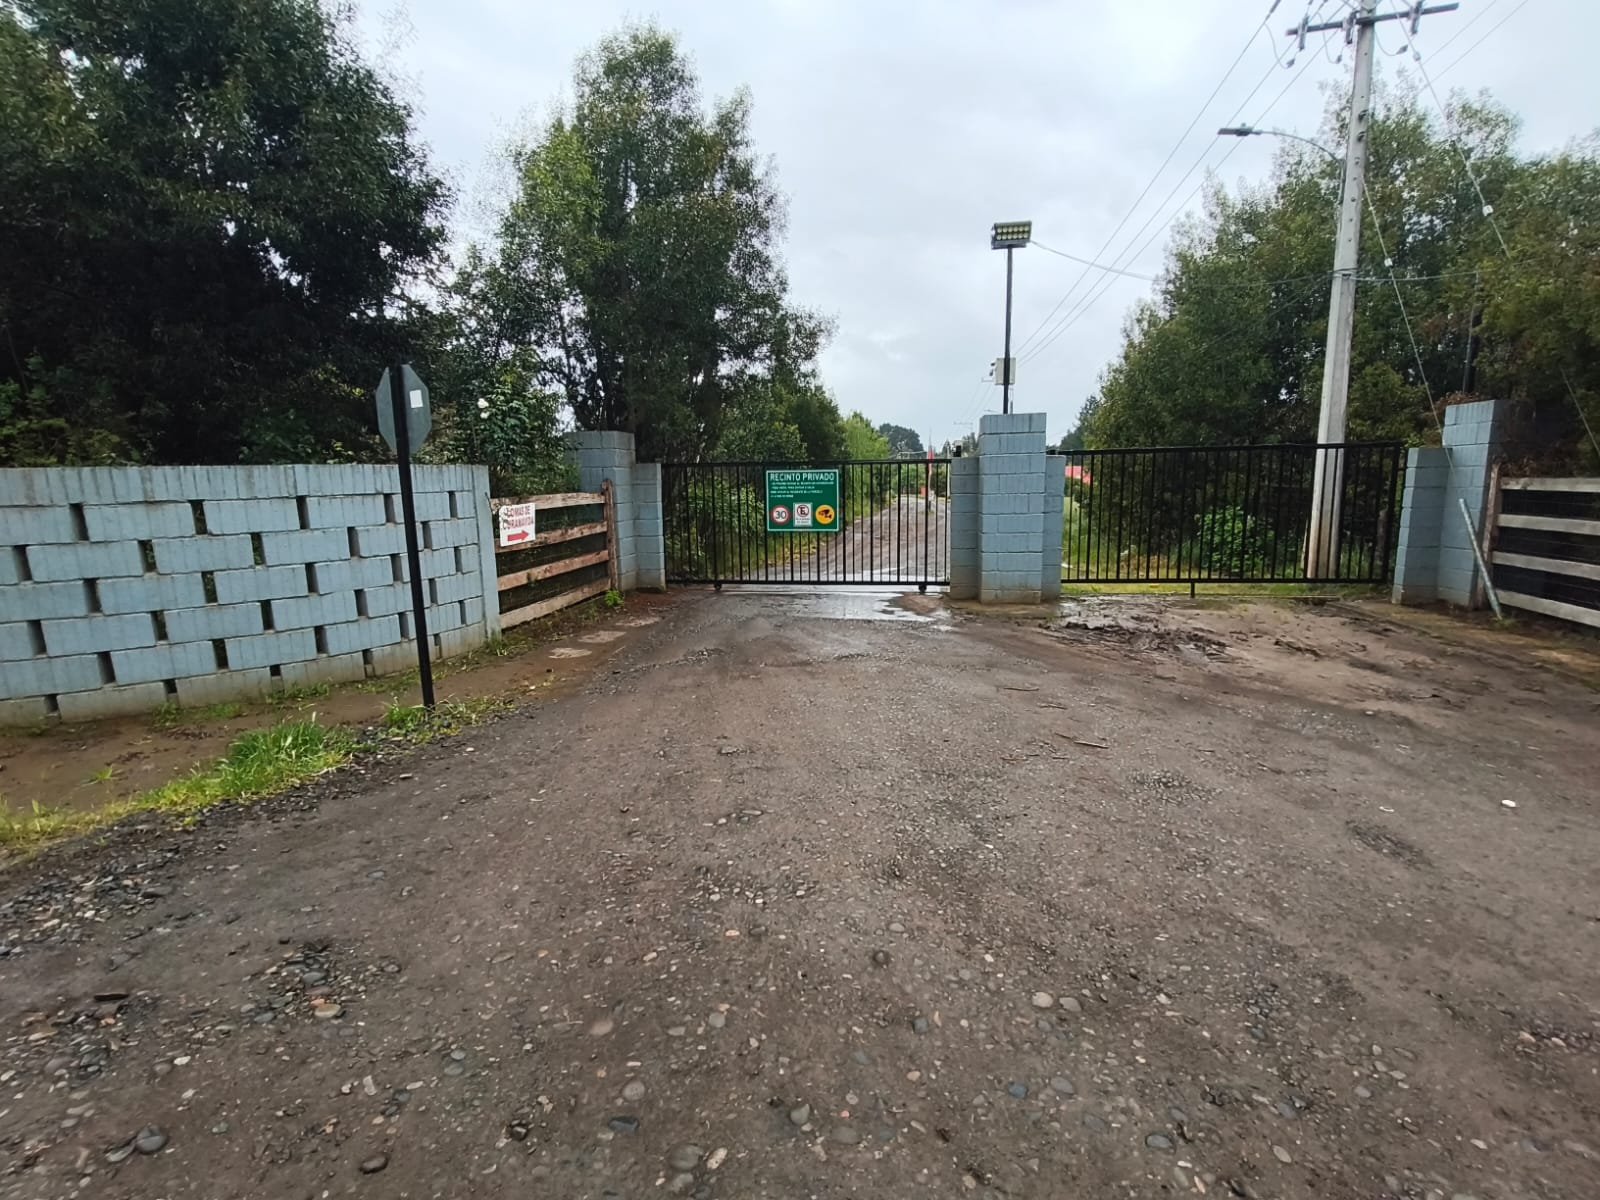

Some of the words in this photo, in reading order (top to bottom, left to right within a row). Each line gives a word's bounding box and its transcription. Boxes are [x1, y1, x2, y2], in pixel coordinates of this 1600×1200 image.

[770, 473, 801, 481] RECINTO
[803, 472, 835, 481] PRIVADO
[775, 511, 787, 519] 30
